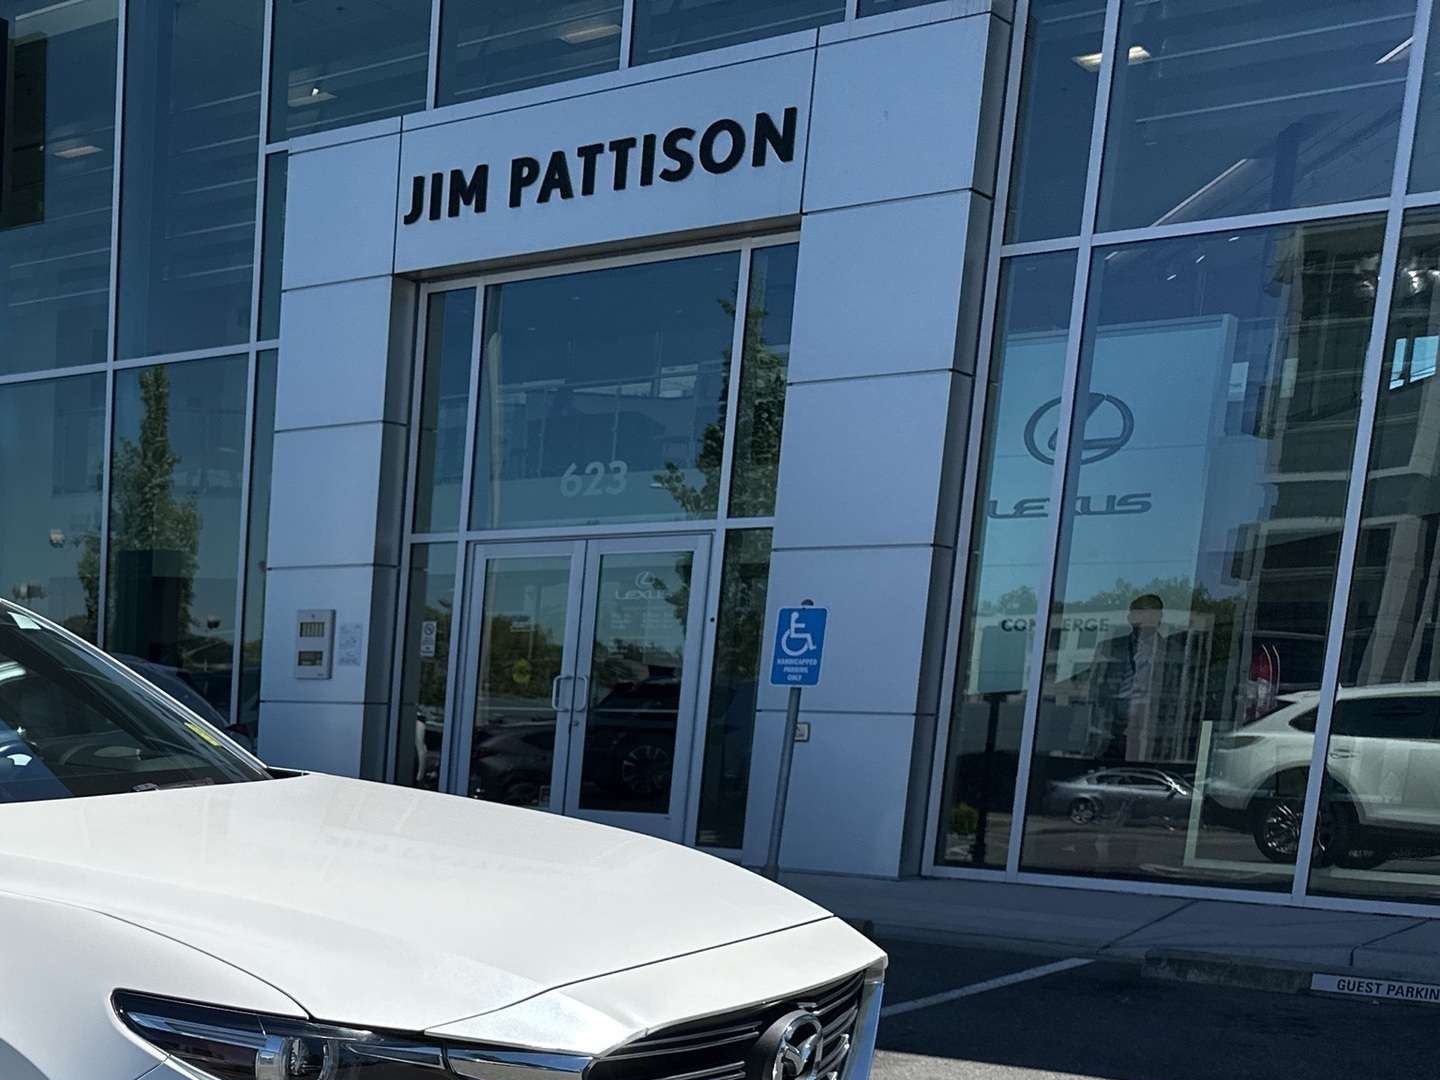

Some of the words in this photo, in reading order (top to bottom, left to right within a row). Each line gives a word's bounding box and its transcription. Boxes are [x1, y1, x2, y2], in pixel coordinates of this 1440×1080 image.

[404, 164, 489, 225] JIM
[509, 106, 798, 208] PATTISON
[560, 460, 628, 497] 623
[1337, 979, 1382, 994] GUEST
